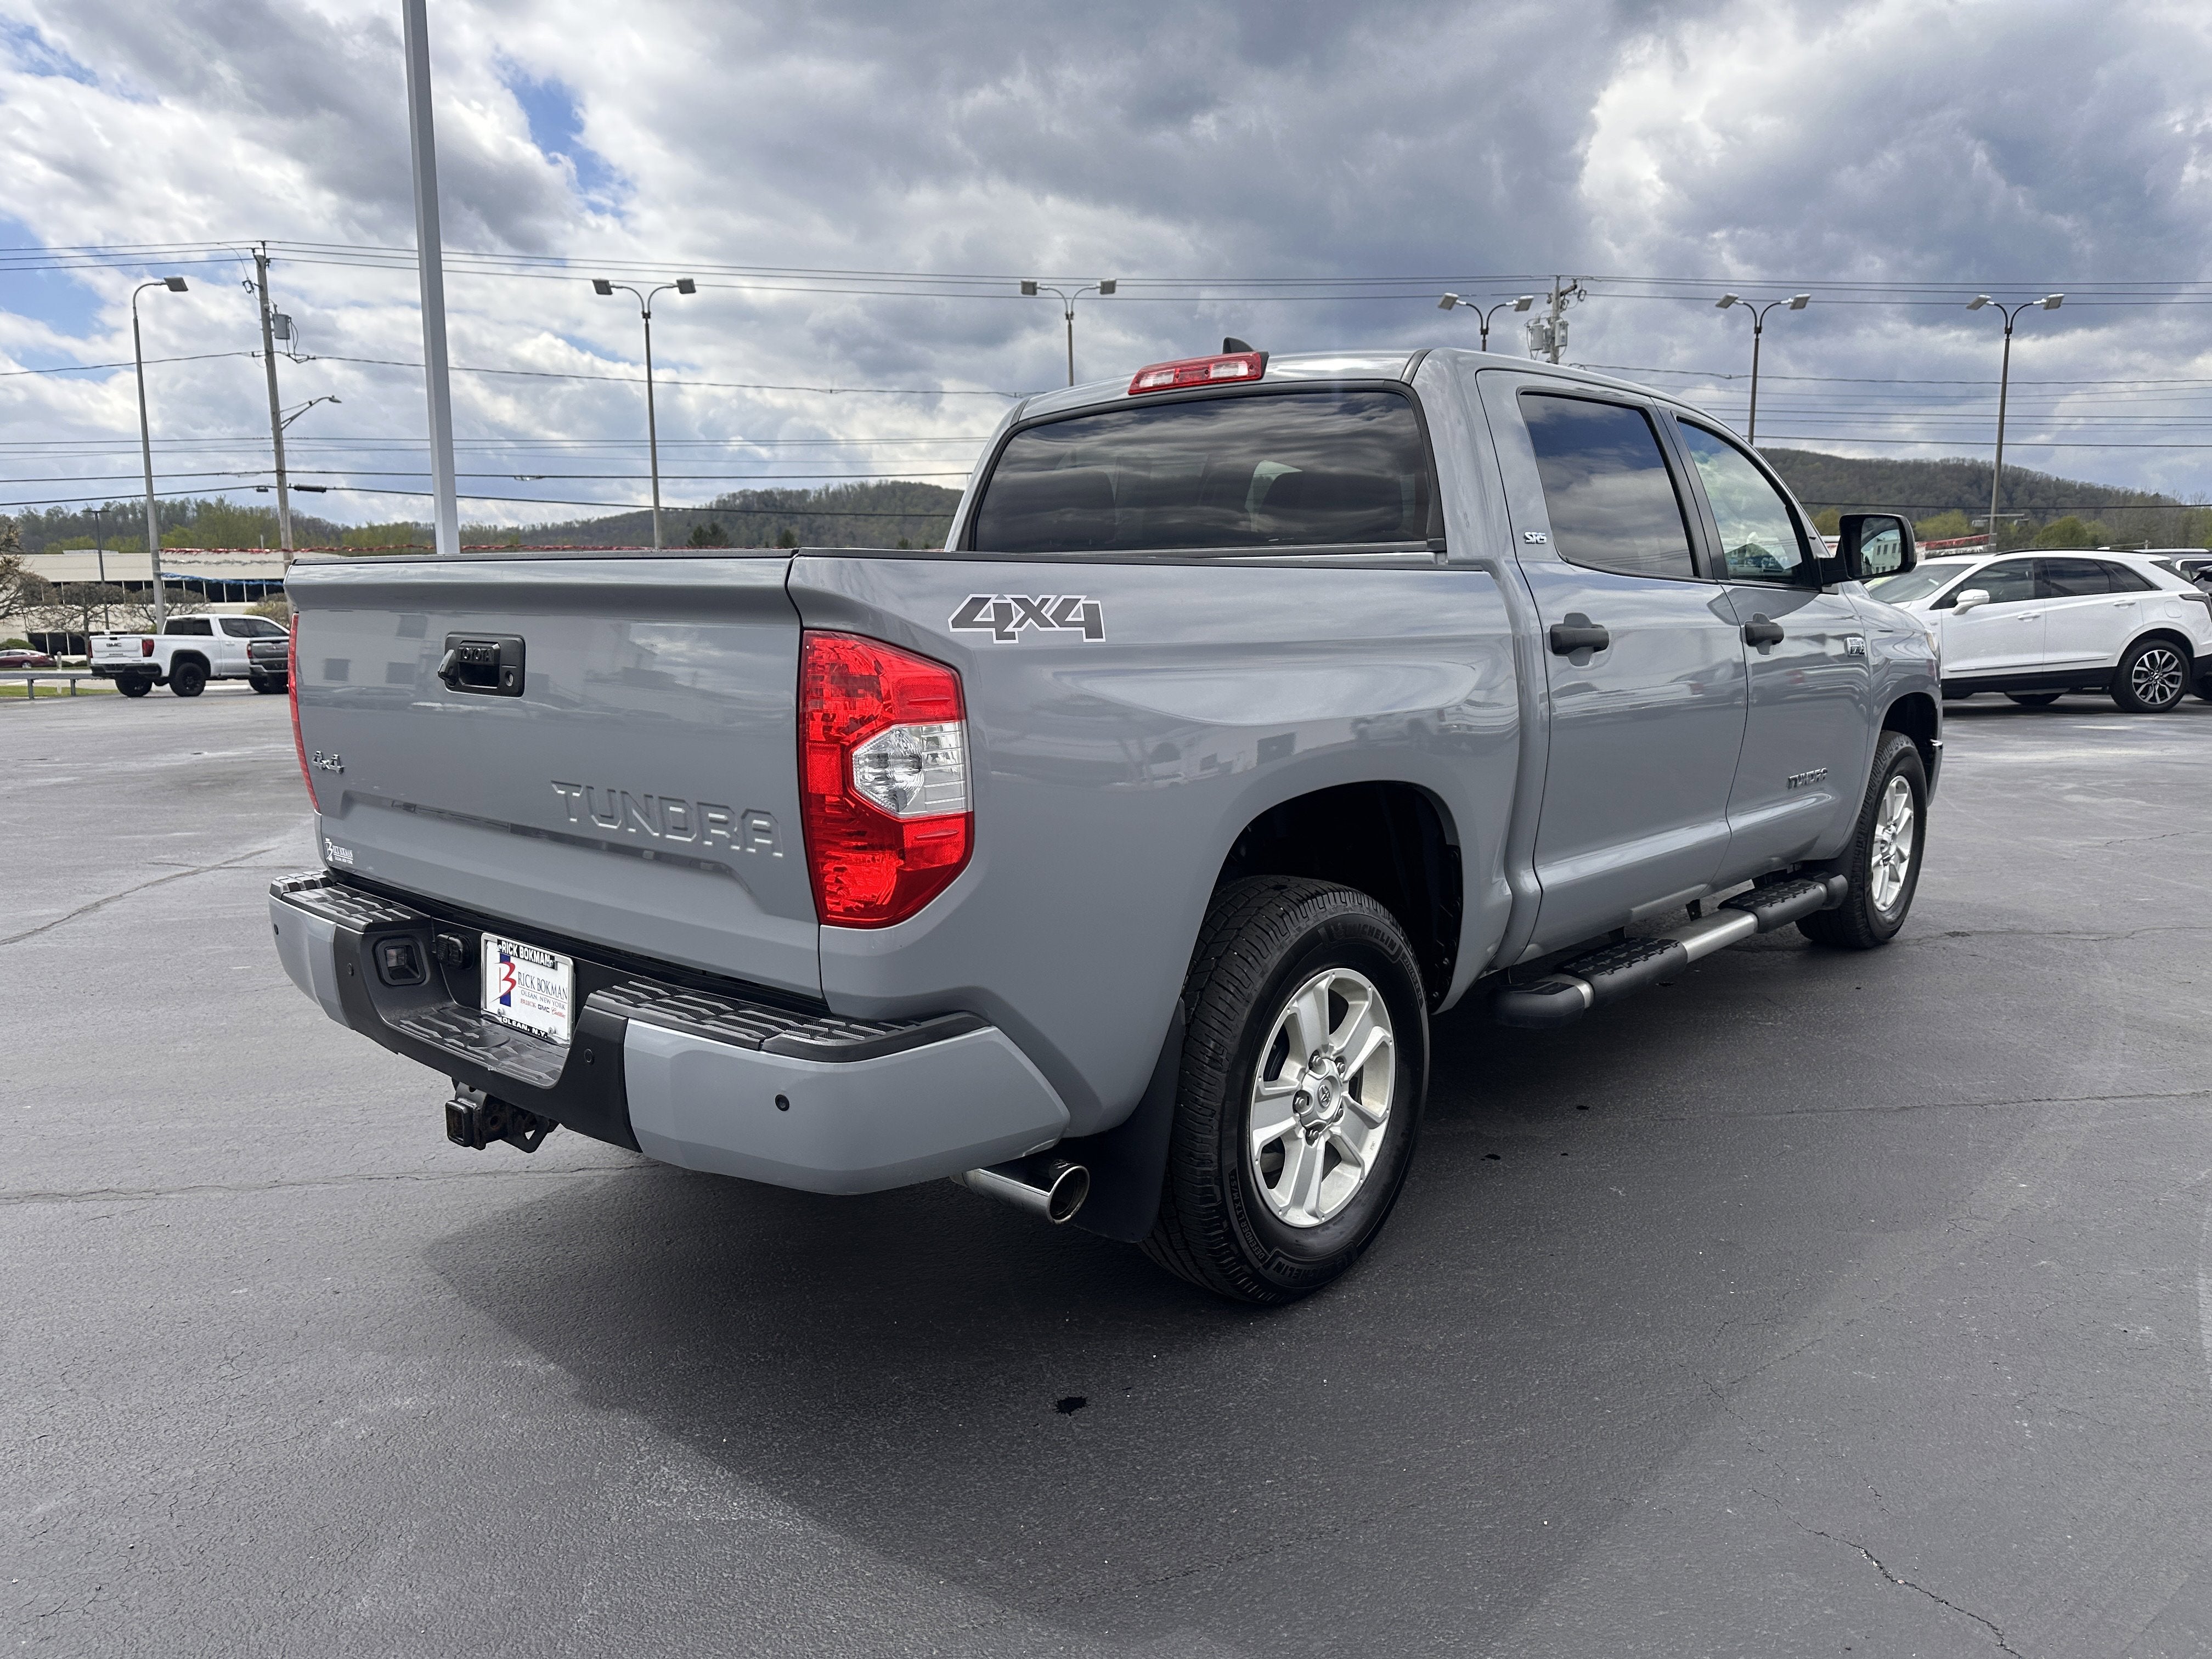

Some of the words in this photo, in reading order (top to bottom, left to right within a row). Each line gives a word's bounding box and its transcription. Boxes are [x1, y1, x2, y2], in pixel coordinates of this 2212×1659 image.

[550, 780, 783, 857] TUNDRA
[1346, 923, 1397, 952] MICHELIN
[501, 940, 518, 957] RICK
[519, 945, 551, 966] BOKMAN
[518, 972, 535, 990] RICK
[537, 977, 568, 1000] BOKMAN
[521, 998, 536, 1008] BUICK
[538, 1004, 550, 1013] GMC
[540, 996, 551, 1005] NEW
[552, 1000, 566, 1010] YORK
[532, 1028, 547, 1039] N.Y.
[1234, 1201, 1245, 1221] LTX
[1240, 1220, 1266, 1260] DEFENDER
